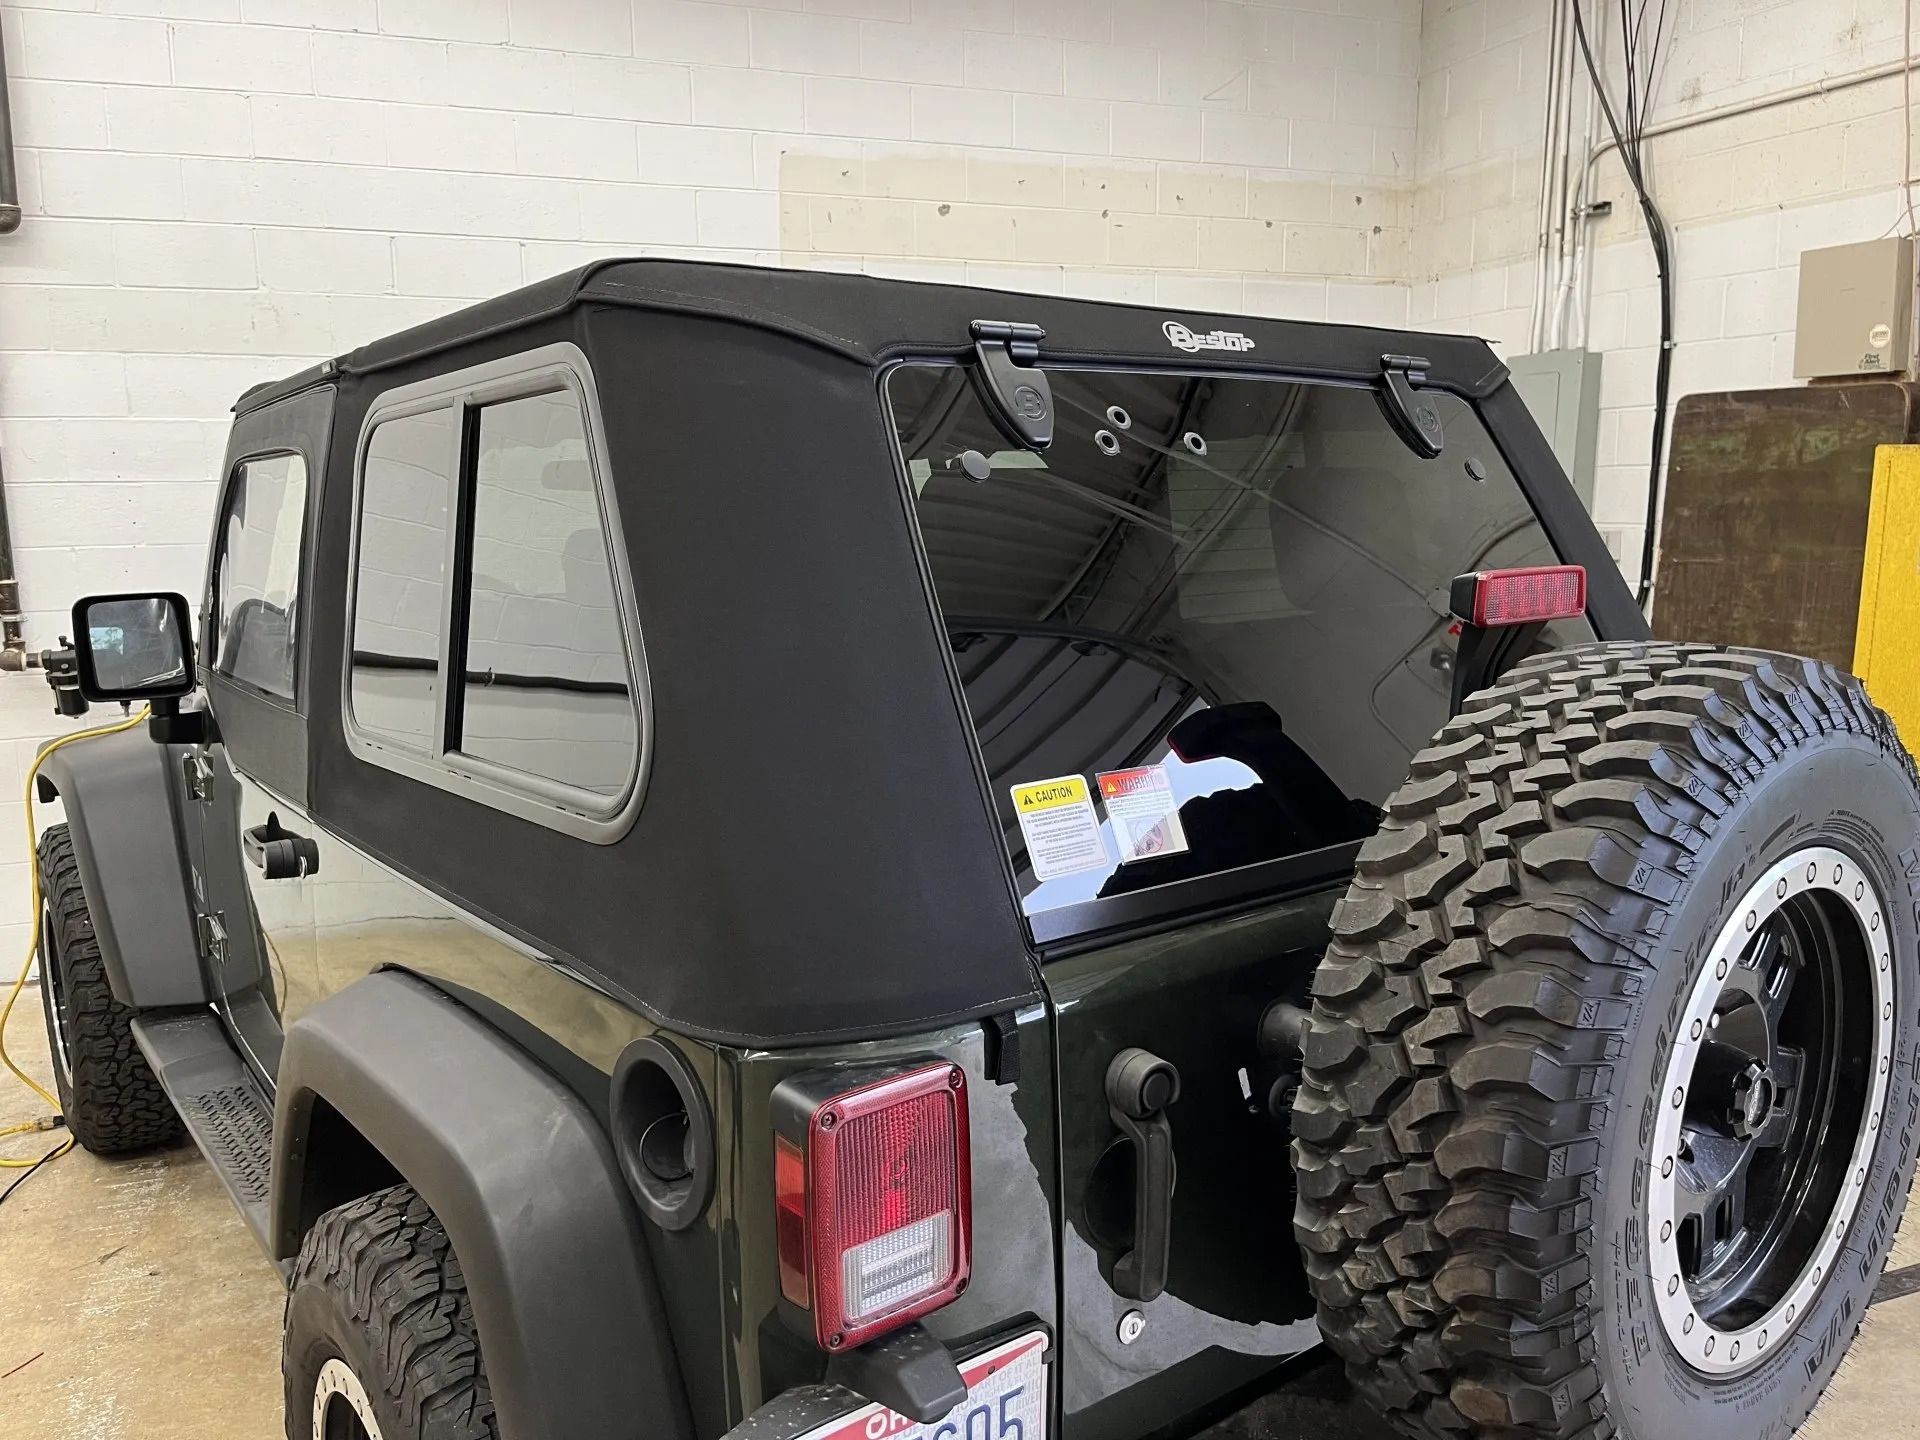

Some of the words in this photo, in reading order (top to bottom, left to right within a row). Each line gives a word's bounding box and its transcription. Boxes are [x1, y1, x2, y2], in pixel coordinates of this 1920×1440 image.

[1117, 773, 1164, 791] WARNI
[1036, 786, 1073, 802] CAUTION
[865, 1409, 908, 1440] OH
